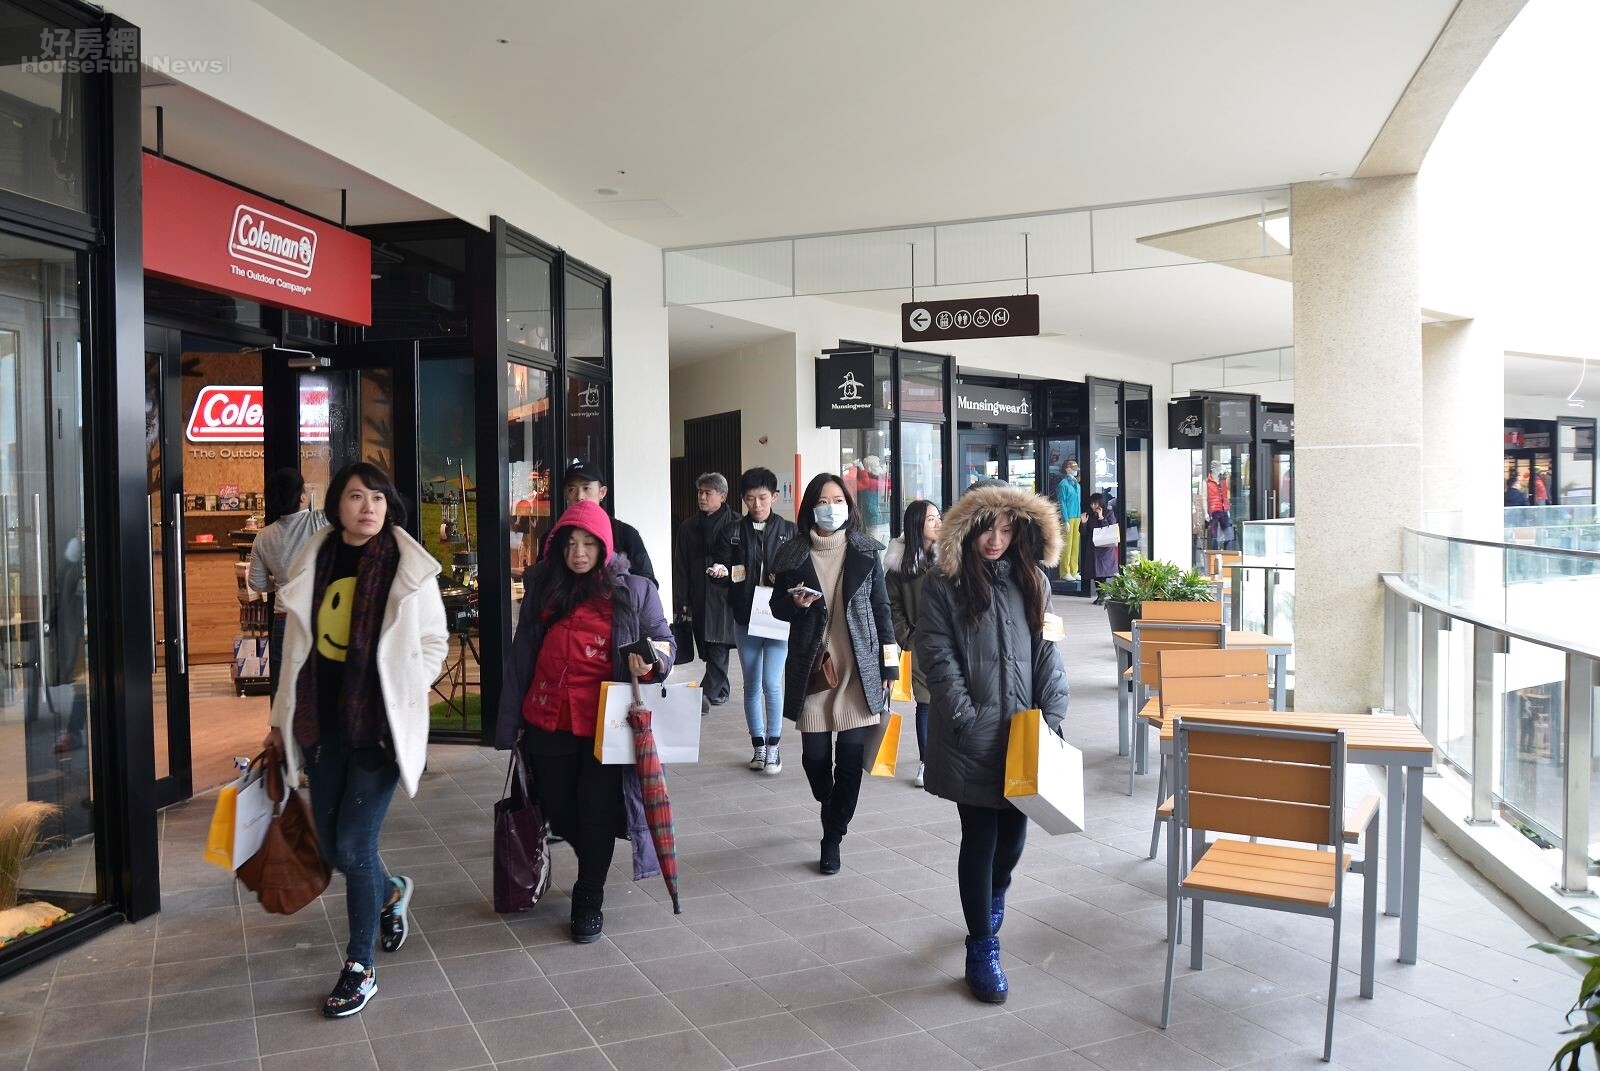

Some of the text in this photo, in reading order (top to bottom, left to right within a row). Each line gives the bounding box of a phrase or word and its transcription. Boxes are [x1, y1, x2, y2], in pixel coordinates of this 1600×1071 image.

[238, 214, 298, 260] Coleman
[231, 264, 245, 277] The
[246, 269, 275, 286] Outdoor
[831, 402, 871, 410] Munsingwear
[958, 395, 1020, 415] Munsingwear
[191, 448, 264, 459] The Outdo
